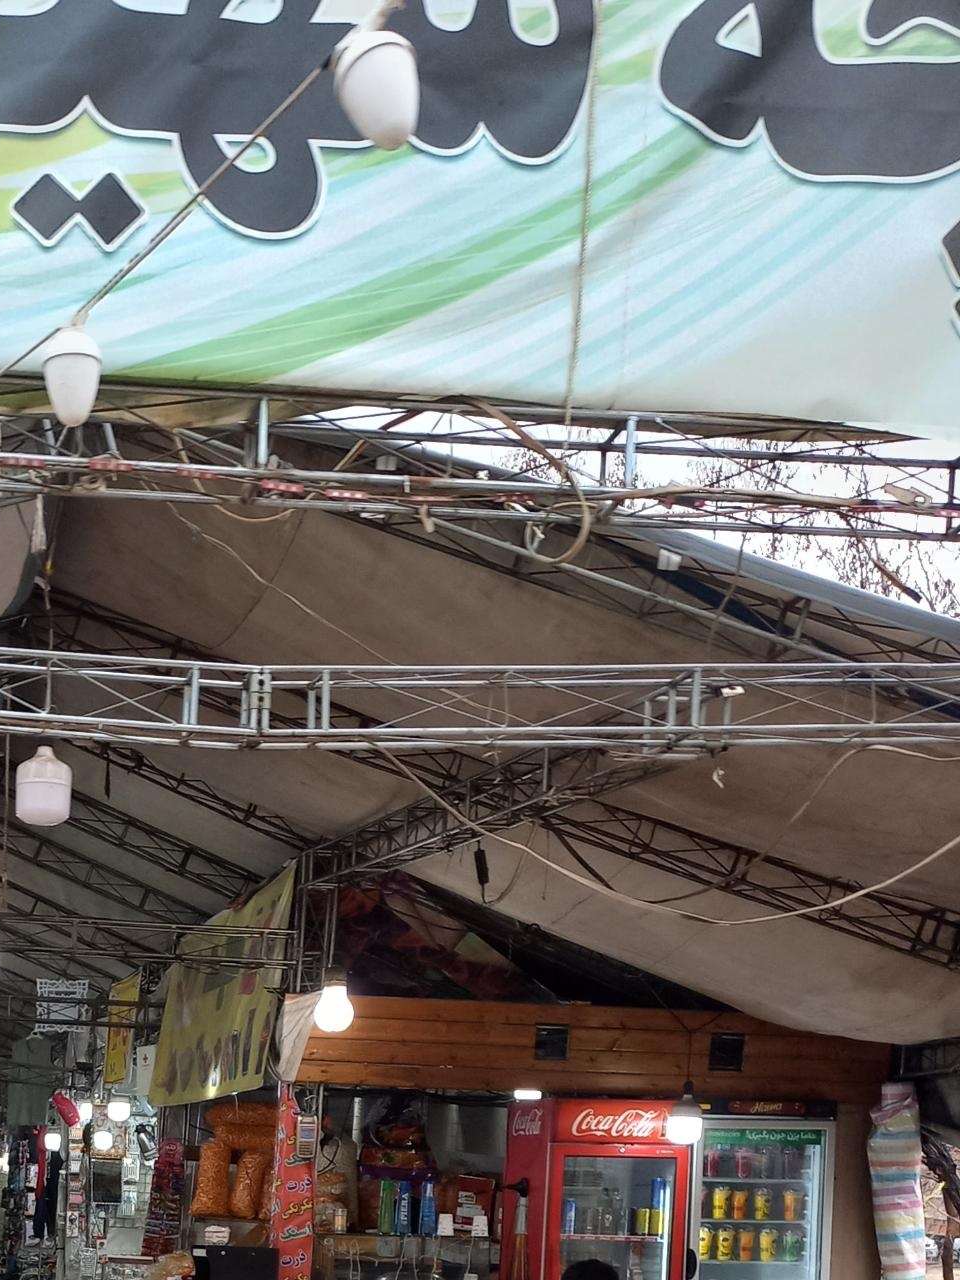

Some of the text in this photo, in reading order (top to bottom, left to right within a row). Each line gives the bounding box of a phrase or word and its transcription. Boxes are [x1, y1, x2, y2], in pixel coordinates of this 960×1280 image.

[571, 1107, 660, 1138] Coca-Cola
[286, 1174, 312, 1193] ذرت
[280, 1249, 308, 1267] ذرت
